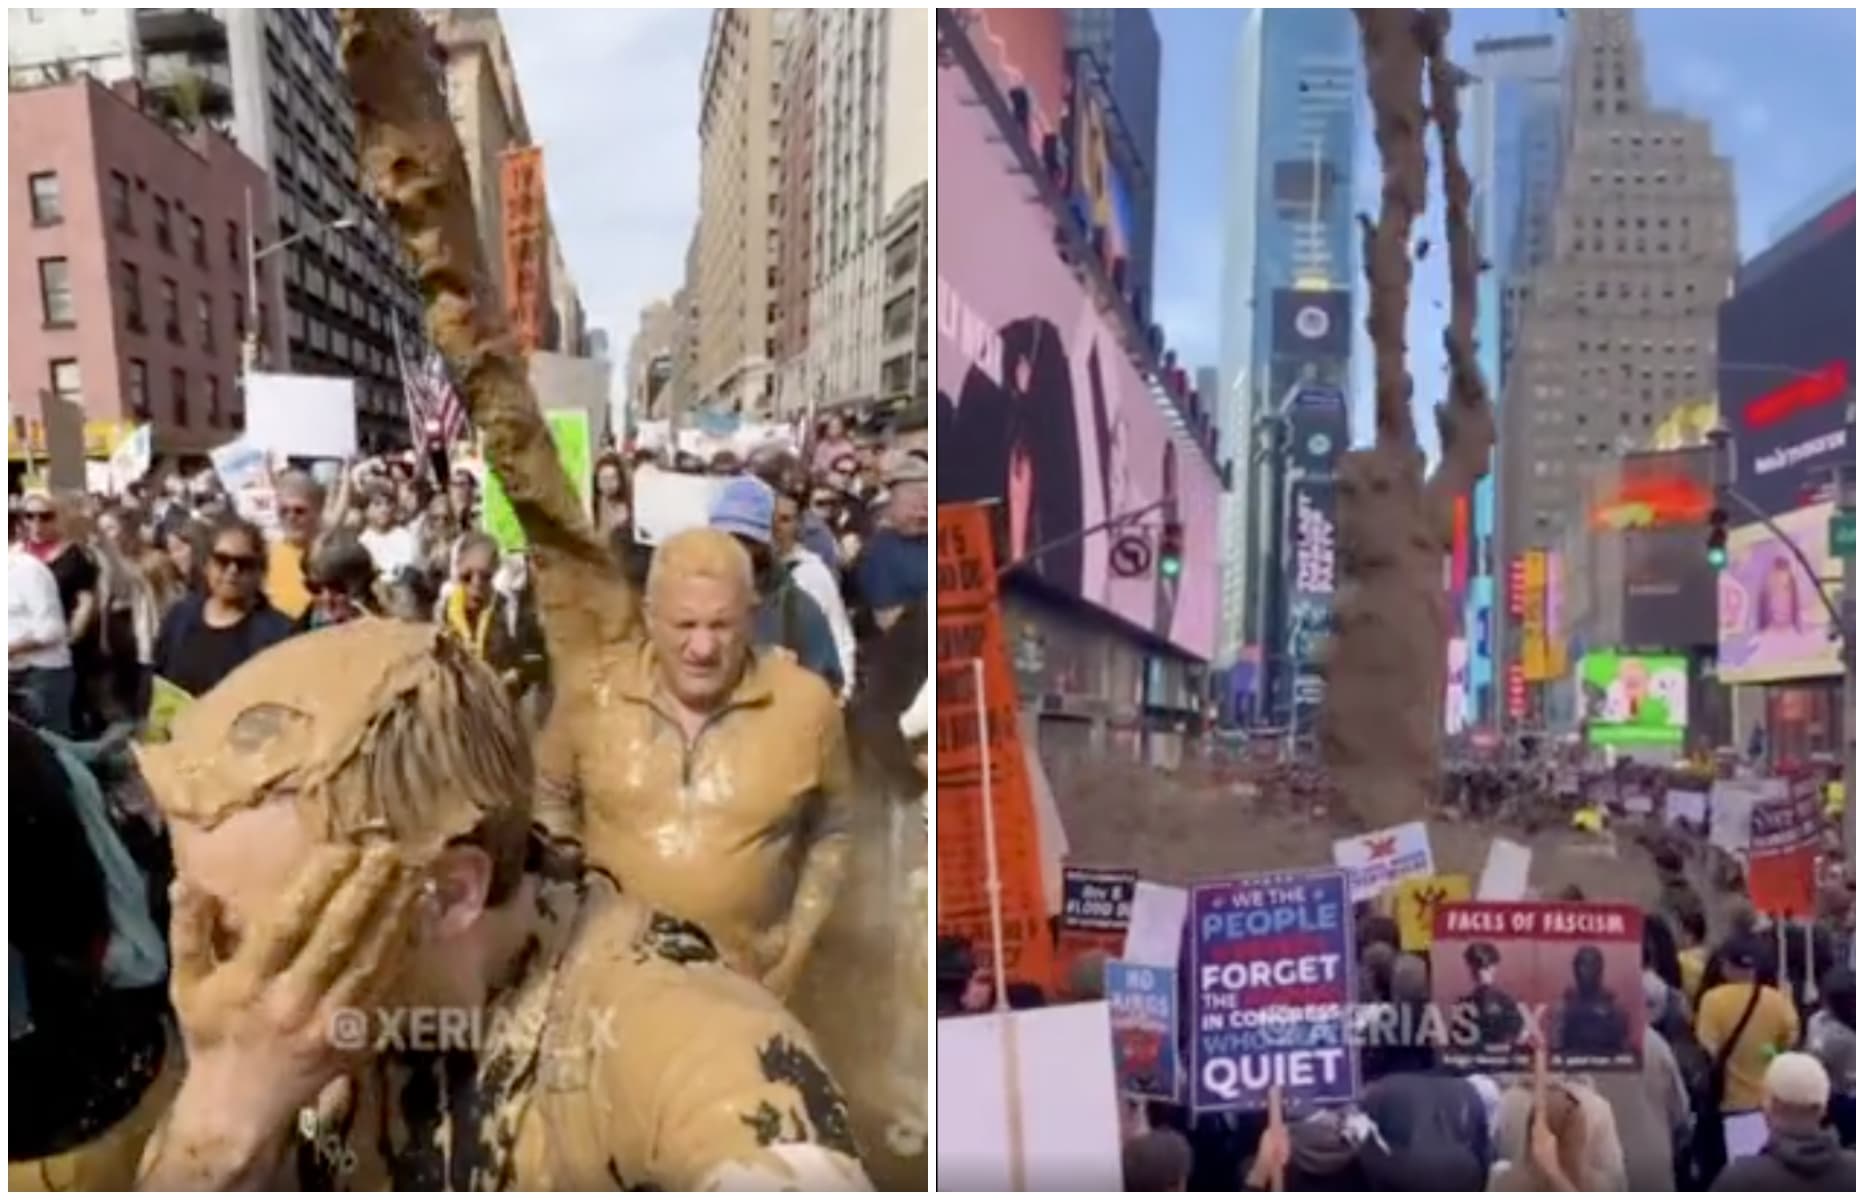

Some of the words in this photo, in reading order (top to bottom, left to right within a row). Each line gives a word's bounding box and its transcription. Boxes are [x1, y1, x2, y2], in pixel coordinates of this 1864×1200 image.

[1232, 891, 1264, 908] WE
[1270, 885, 1306, 905] THE
[1203, 903, 1338, 940] PEOPLE
[1447, 910, 1504, 932] FACES
[1511, 911, 1536, 932] OF
[1543, 911, 1625, 934] FASCISM
[1202, 953, 1340, 991] FORGET
[1203, 992, 1239, 1009] THE
[1202, 1013, 1225, 1031] IN
[1203, 1049, 1344, 1099] QUIET
